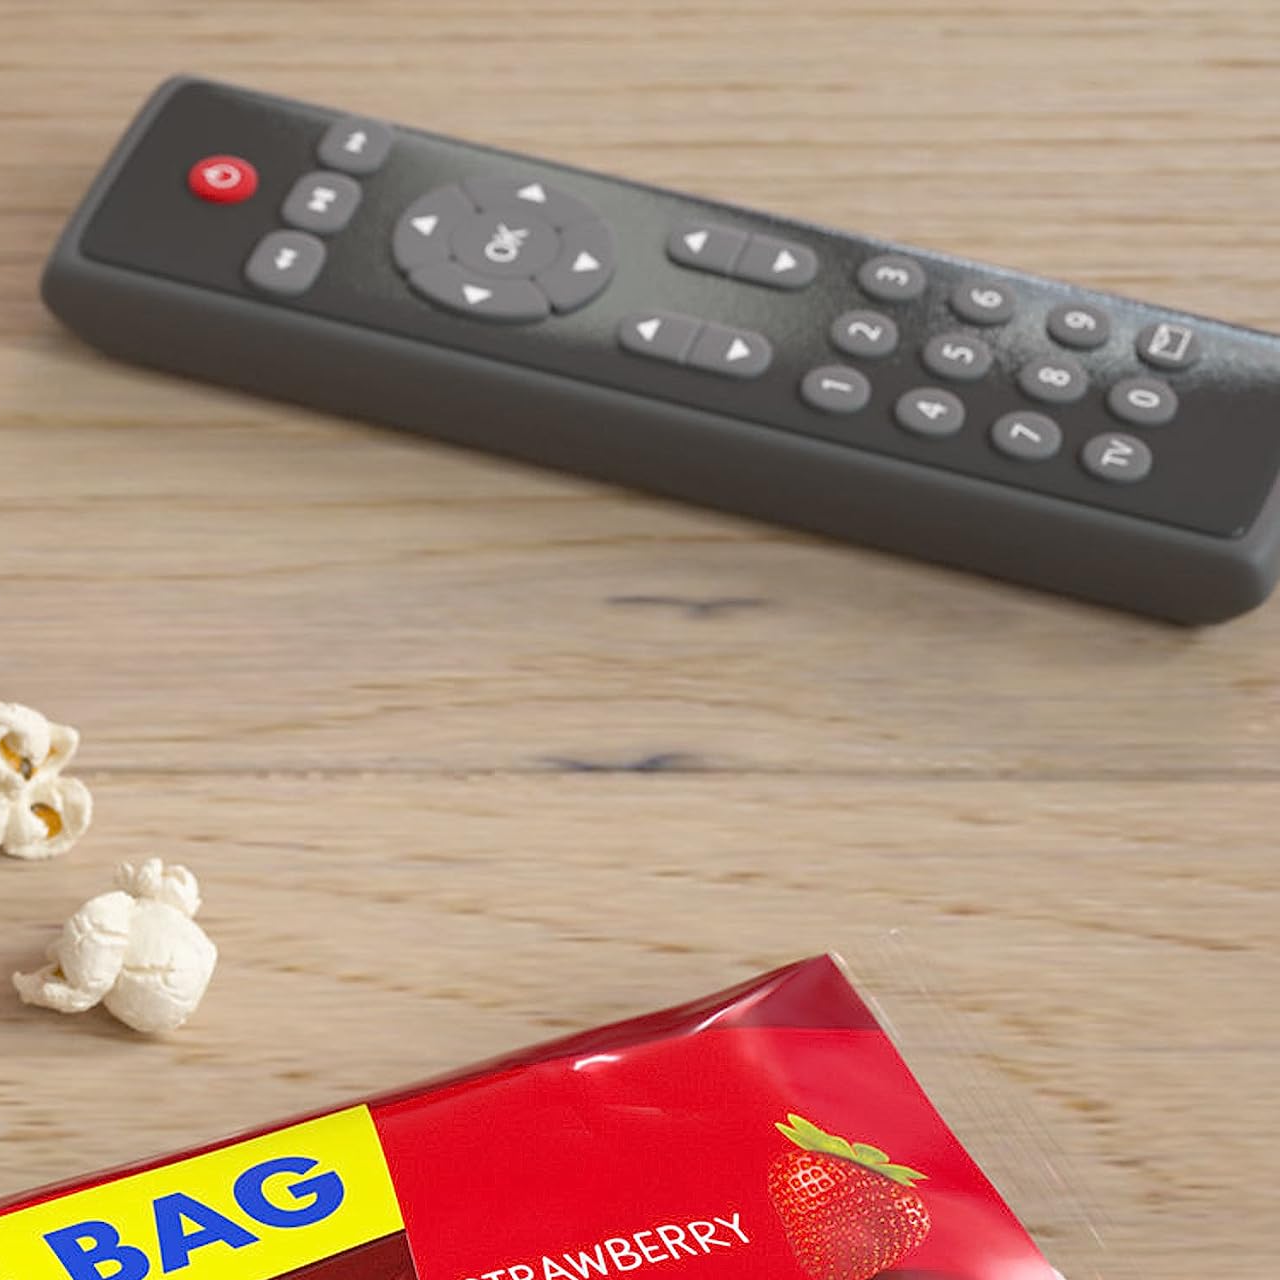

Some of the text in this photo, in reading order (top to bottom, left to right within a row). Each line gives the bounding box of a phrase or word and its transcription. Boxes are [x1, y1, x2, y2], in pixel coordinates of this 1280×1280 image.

[484, 222, 529, 263] OK
[875, 266, 909, 287] 3
[970, 289, 1003, 309] 6
[1064, 311, 1096, 331] 9
[848, 321, 882, 342] 2
[942, 343, 974, 364] 5
[821, 376, 854, 393] 1
[1038, 367, 1071, 387] 8
[1127, 389, 1161, 408] 0
[916, 399, 948, 419] 4
[1009, 423, 1042, 443] 7
[1101, 438, 1134, 467] TV
